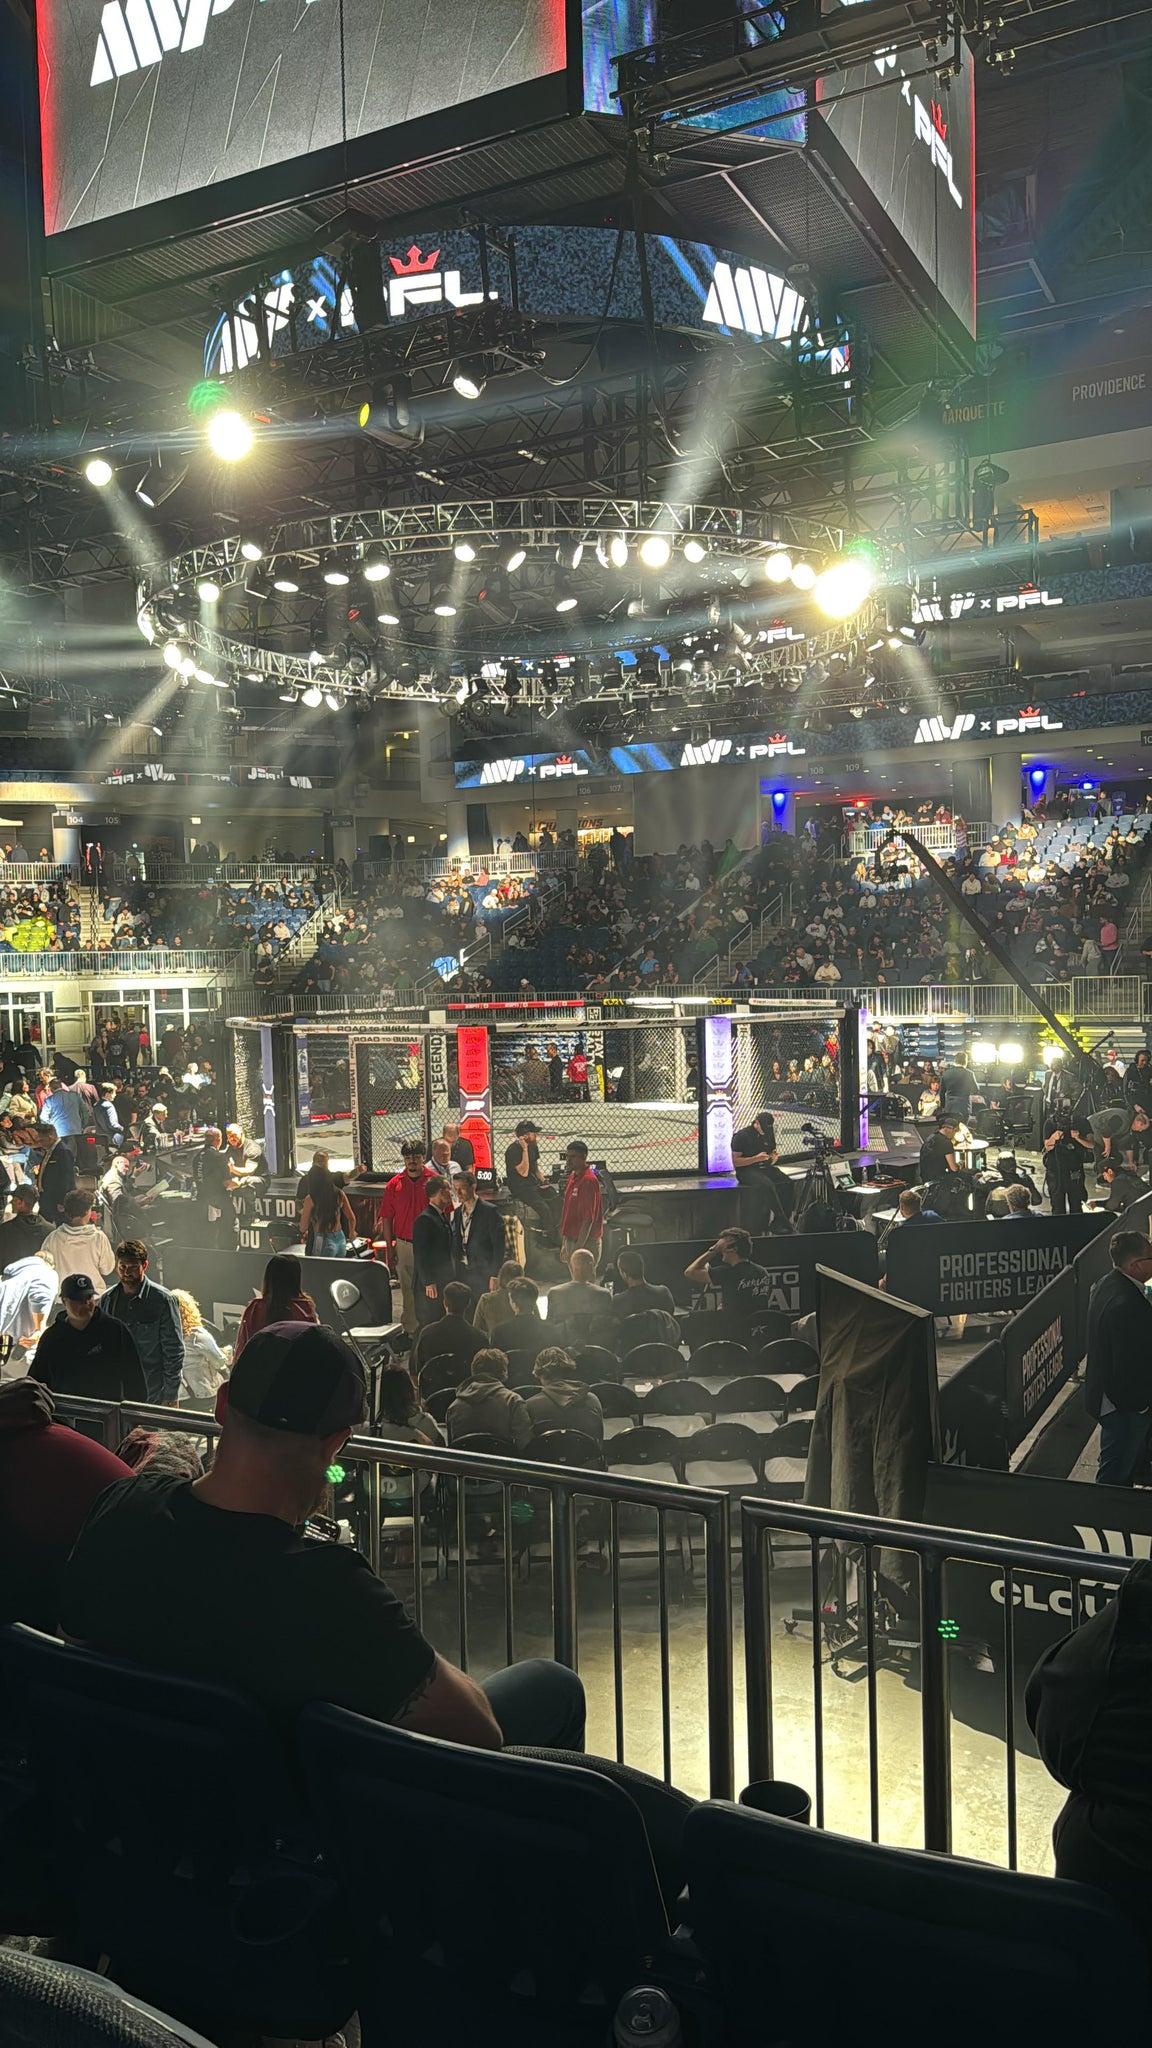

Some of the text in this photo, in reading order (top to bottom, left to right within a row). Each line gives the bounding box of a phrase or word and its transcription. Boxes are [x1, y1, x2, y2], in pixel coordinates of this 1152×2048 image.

[1072, 374, 1146, 402] PROVIDENCE
[997, 591, 1063, 612] PFL
[997, 715, 1063, 735] PFL
[750, 742, 806, 759] PFL
[540, 762, 588, 778] PFL
[810, 763, 859, 775] 108 109
[579, 784, 622, 795] 106 107
[68, 816, 119, 824] 104 105
[351, 1112, 359, 1144] ROAD
[477, 1171, 492, 1181] 5:00
[276, 1199, 296, 1217] DO
[939, 1246, 1067, 1279] PROFESSIONAL
[940, 1278, 1011, 1302] FIGHTERS
